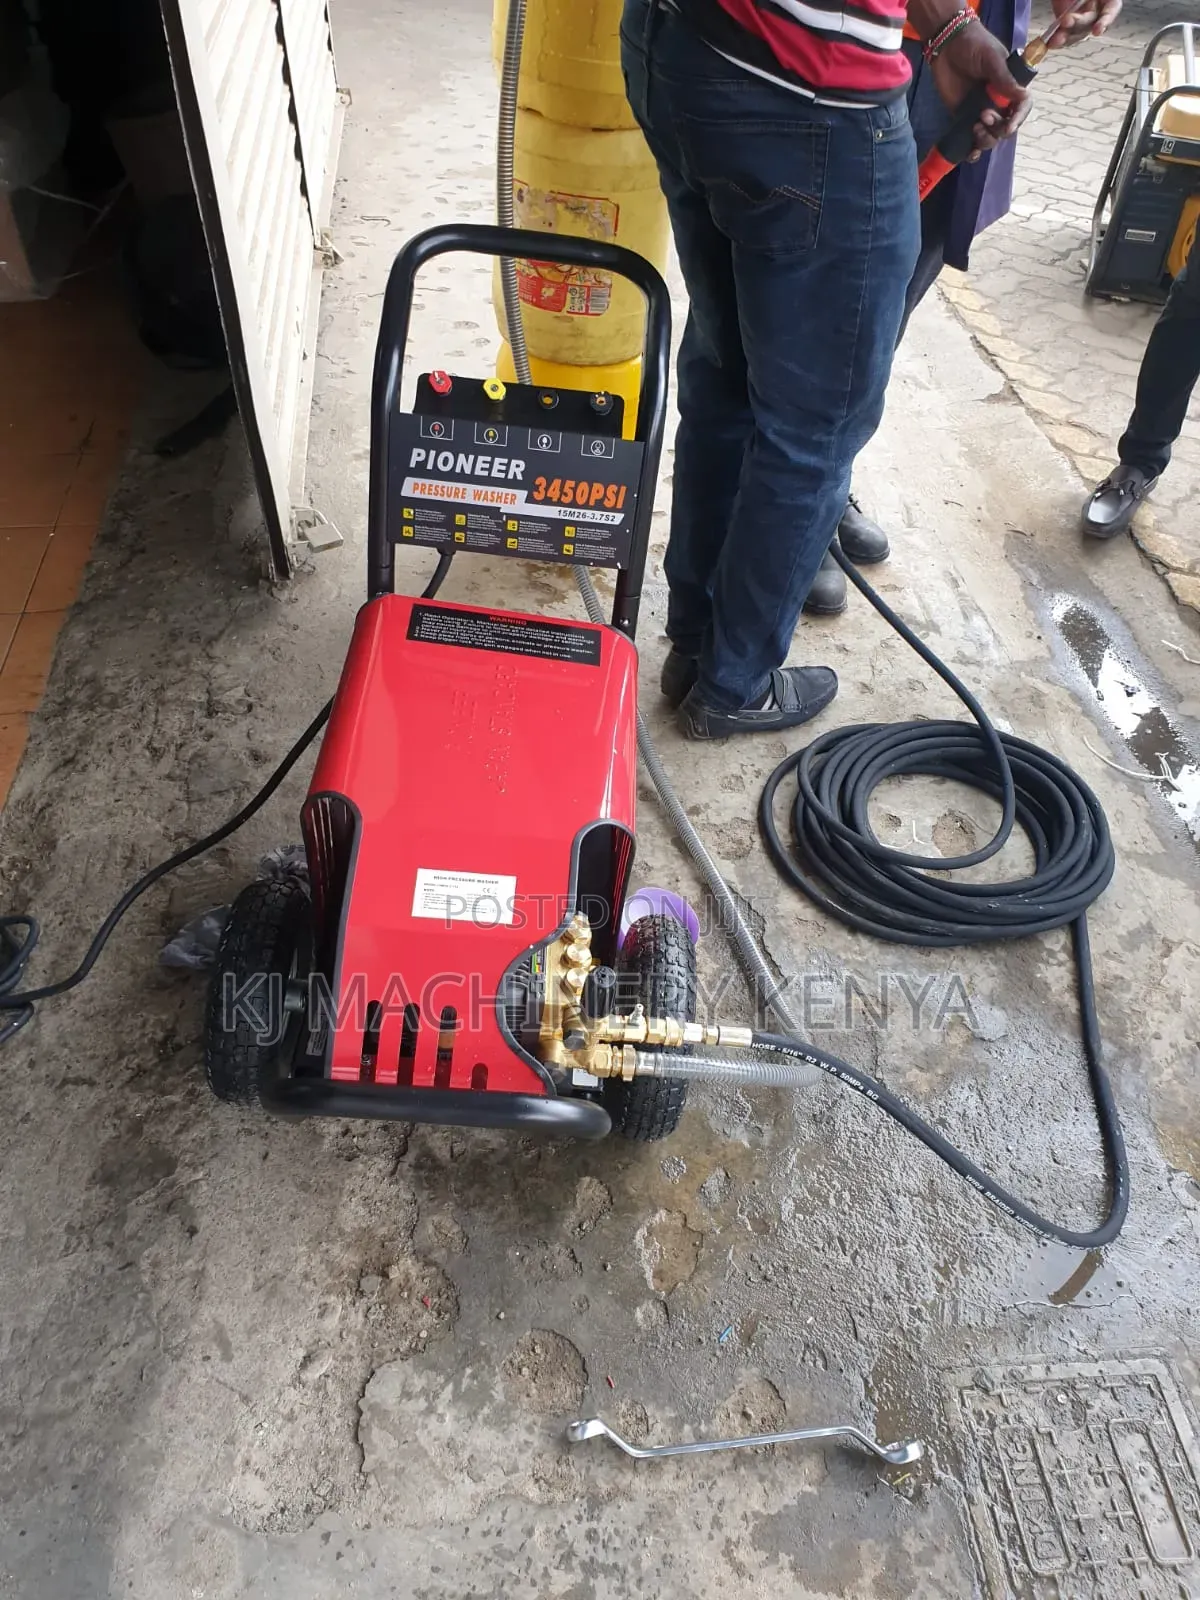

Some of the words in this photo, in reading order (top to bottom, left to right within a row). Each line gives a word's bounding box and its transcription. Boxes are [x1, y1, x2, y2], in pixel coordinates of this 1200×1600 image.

[409, 447, 526, 481] PIONEER
[412, 482, 467, 500] PRESSURE
[473, 489, 517, 505] WASHER
[533, 476, 627, 509] 3450PSI
[558, 509, 616, 522] 15M26-3.7S2
[489, 615, 526, 625] WARNING
[752, 1042, 776, 1051] HOSE
[805, 1054, 817, 1063] R2
[965, 1174, 985, 1191] WIRE
[984, 1191, 1016, 1216] BRAIDED
